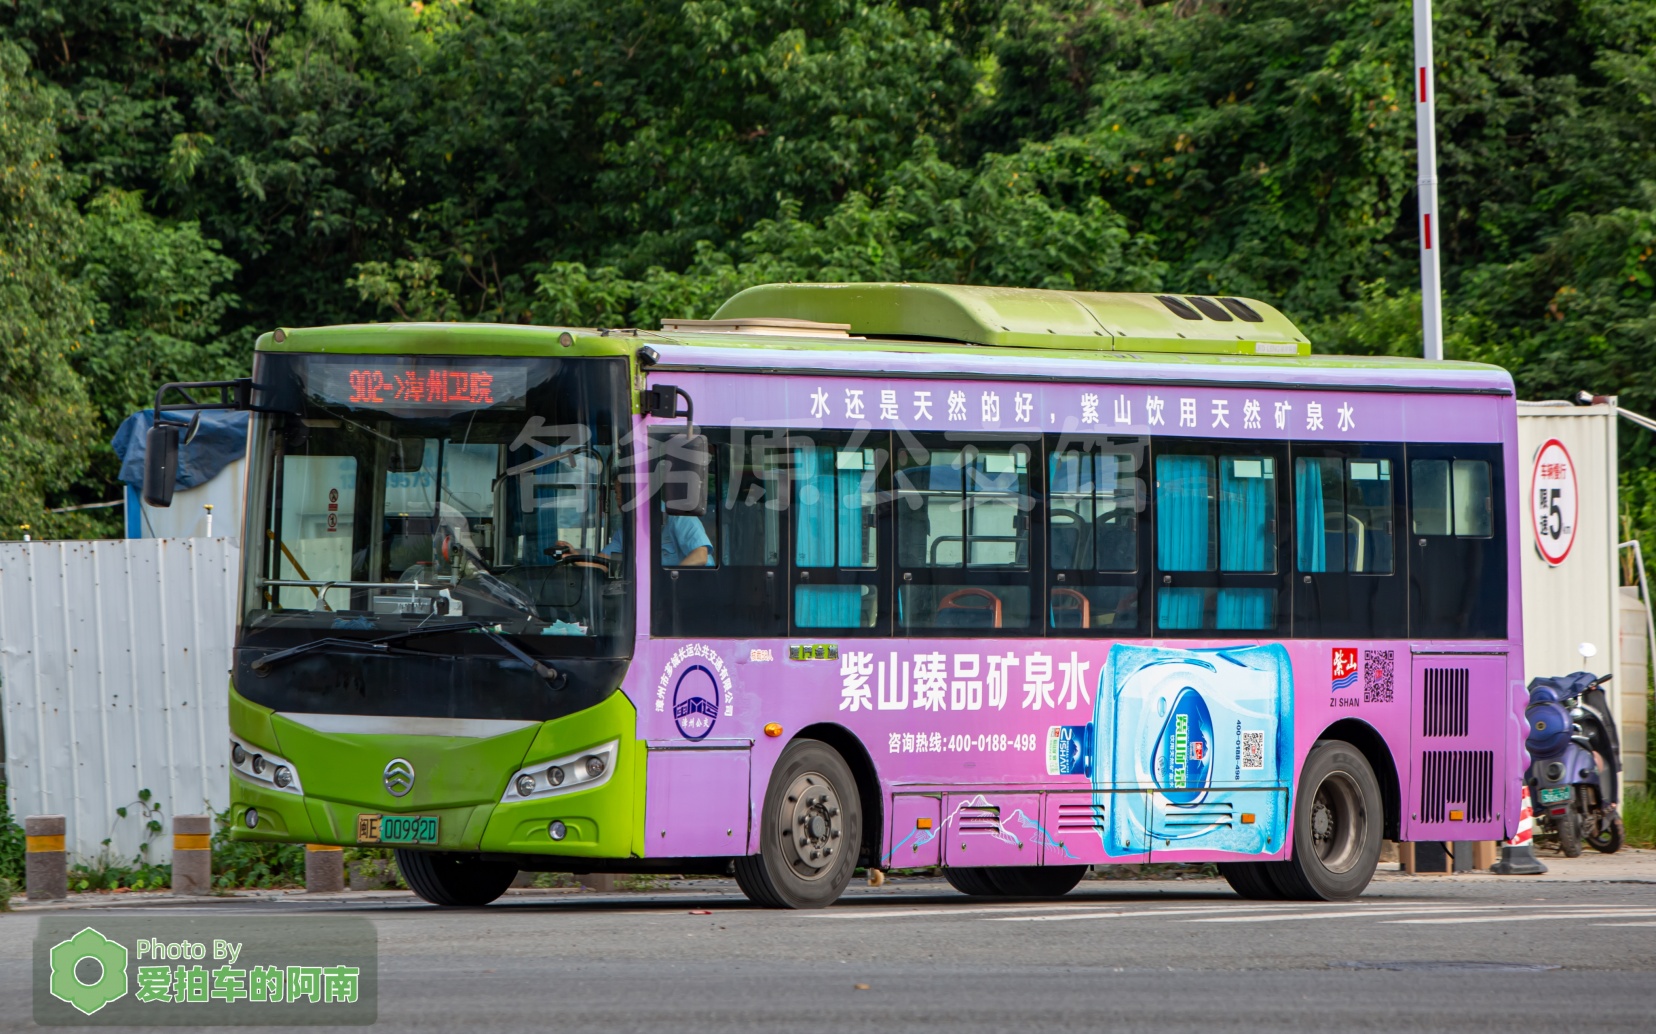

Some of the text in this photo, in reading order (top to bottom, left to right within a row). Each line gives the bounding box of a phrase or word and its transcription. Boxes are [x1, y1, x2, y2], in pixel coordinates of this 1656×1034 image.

[1549, 489, 1562, 540] 5
[838, 650, 1091, 712] 紫山臻品矿泉水
[1332, 649, 1358, 676] 紫山
[1338, 697, 1360, 708] SHAN
